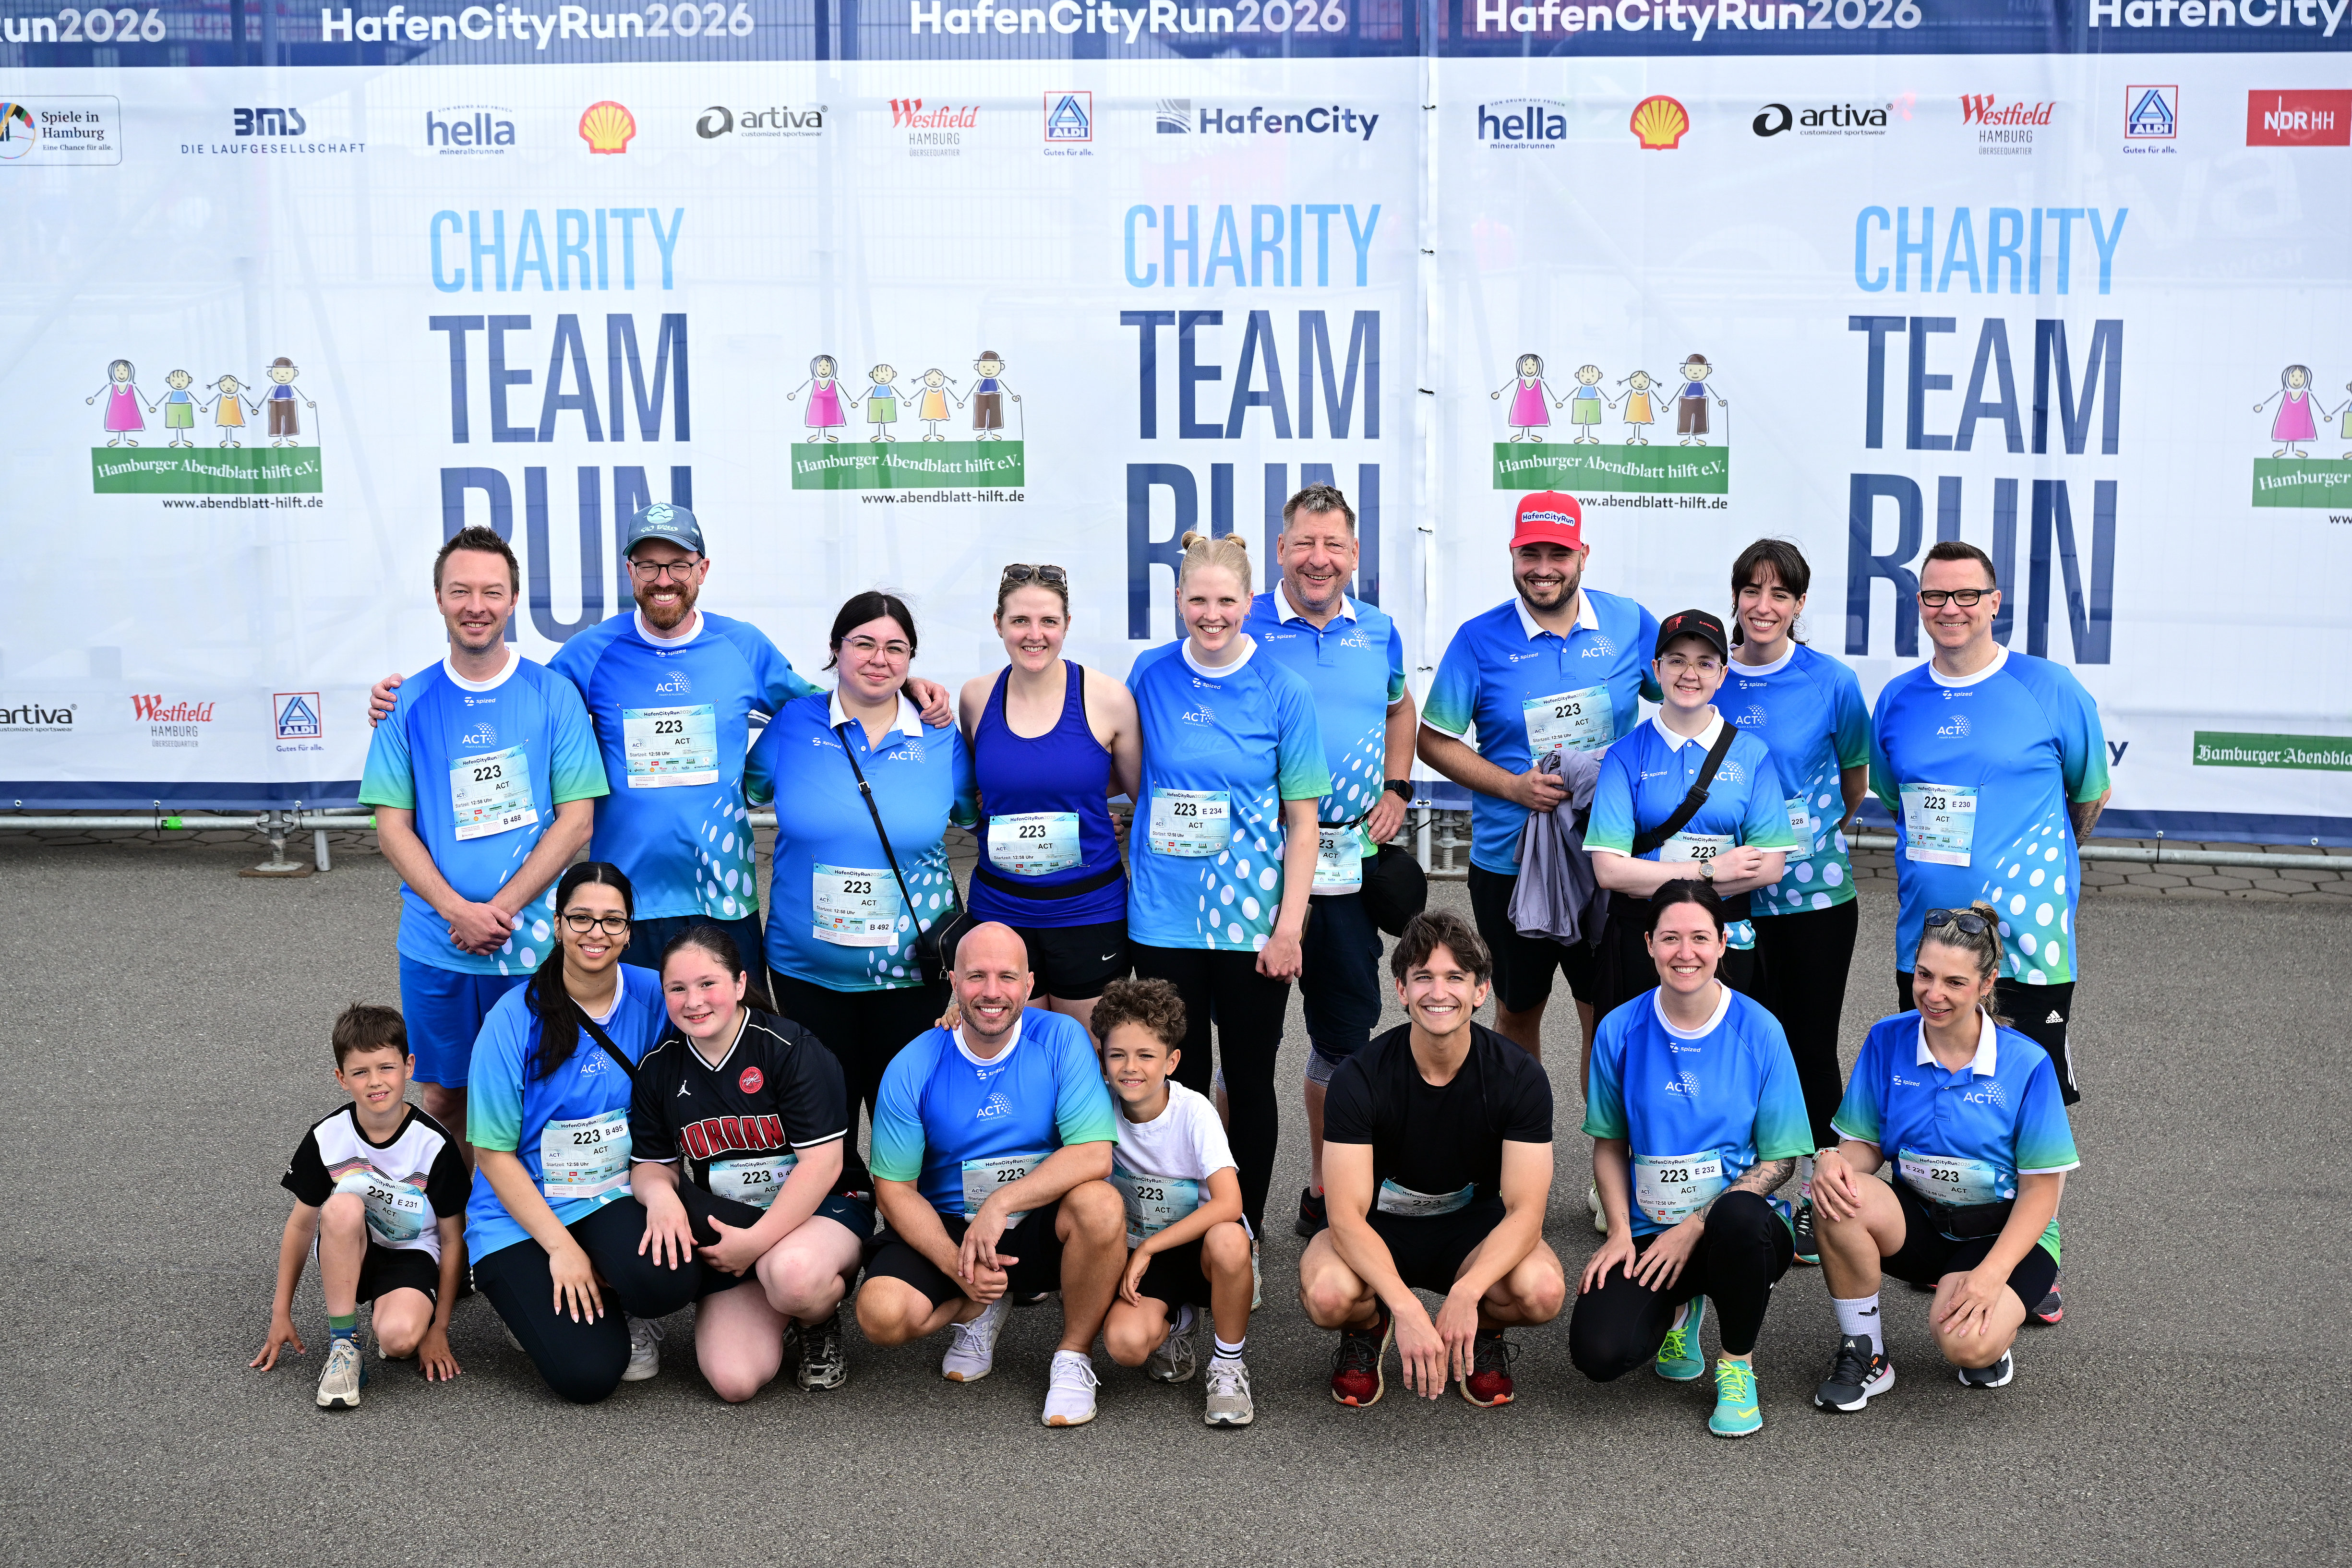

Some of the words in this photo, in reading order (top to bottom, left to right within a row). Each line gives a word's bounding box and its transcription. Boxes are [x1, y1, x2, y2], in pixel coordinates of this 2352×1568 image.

[0, 7, 166, 43] un2026
[322, 2, 754, 50] HafenCityRun2026
[912, 0, 1346, 44] HafenCityRun2026
[1476, 0, 1921, 41] HafenCityRun2026
[888, 97, 981, 129] Westfield
[1958, 94, 2056, 127] Westfield
[41, 111, 82, 125] Spiele
[86, 111, 99, 122] in
[234, 108, 306, 136] BMS
[1200, 105, 1379, 140] HafenCity
[1478, 104, 1567, 141] hella
[2264, 111, 2307, 131] NDR
[2311, 110, 2334, 131] HH
[42, 127, 105, 141] Hamburg
[427, 110, 515, 146] hella
[1052, 127, 1086, 138] ALDI
[2133, 123, 2170, 134] ALDI
[909, 132, 960, 145] HAMBURG
[1979, 130, 2033, 143] HAMBURG
[181, 145, 205, 154] DIE
[212, 144, 366, 154] LAUFGESELLSCHAFT
[909, 147, 960, 156] ÜBERSEEQUARTIER
[1979, 145, 2032, 155] ÜBERSEEQUARTIER
[2123, 145, 2146, 155] Gutes
[2148, 145, 2161, 155] für
[2162, 145, 2177, 154] alle.
[430, 207, 684, 293] CHARITY
[1124, 203, 1381, 288] CHARITY
[1855, 205, 2129, 295] CHARITY
[429, 313, 690, 443] TEAM
[1119, 310, 1381, 440] TEAM
[1848, 315, 2124, 455] TEAM
[97, 458, 179, 479] Hamburger
[180, 459, 259, 480] Abendblatt
[262, 464, 292, 479] hilft
[294, 460, 319, 476] e.V.
[796, 454, 879, 474] Hamburger
[881, 454, 962, 473] Abendblatt
[965, 458, 995, 473] hilft
[997, 454, 1021, 469] e.V.
[1498, 454, 1582, 474] Hamburger
[1584, 455, 1664, 478] Abendblatt
[1668, 464, 1699, 479] hilft
[1701, 460, 1725, 477] e.V.
[2259, 470, 2351, 491] Hamburger
[162, 496, 324, 509] www.abendblatt-hilft.de
[861, 490, 1025, 503] www.abendblatt-hilft.de
[1578, 494, 1728, 509] ww.abendblatt-hilft.de
[1523, 511, 1575, 525] HafenCityRun
[1582, 647, 1606, 658] ACT
[656, 682, 681, 692] ACT
[1202, 682, 1221, 690] spized
[1543, 692, 1587, 705] HafenCityRun2026
[130, 694, 216, 722] Westfield
[1555, 703, 1581, 718] 223
[151, 725, 198, 737] HAMBURG
[283, 725, 316, 735] ALDI
[655, 720, 683, 734] 223
[1936, 726, 1962, 735] ACT
[152, 739, 199, 748] ÜBERSEEQUARTIER
[462, 734, 488, 744] ACT
[463, 753, 508, 766] HafenCityRun2026
[888, 751, 916, 761] ACT
[2196, 744, 2281, 765] Hamburger
[474, 765, 502, 782] 223
[496, 781, 509, 790] ACT
[1174, 802, 1197, 816] 223
[1924, 796, 1945, 810] 223
[510, 814, 521, 823] 488
[1019, 825, 1046, 838] 223
[1692, 846, 1716, 859] 223
[834, 869, 883, 877] HafenCityRun2026
[844, 880, 871, 894] 223
[1665, 1081, 1690, 1093] ACT
[976, 1104, 1001, 1118] ACT
[561, 1116, 607, 1129] HafenCityRun2026
[573, 1129, 601, 1145] 223
[612, 1125, 623, 1135] 495
[593, 1145, 608, 1155] ACT
[985, 1158, 1036, 1167] HafenCityRun2026
[1920, 1158, 1970, 1167] HafenCityRun2026
[742, 1171, 771, 1185] 223
[1128, 1174, 1175, 1185] HafenCityRun2026
[1660, 1169, 1688, 1183] 223
[1931, 1168, 1959, 1183] 223
[367, 1185, 394, 1205] 223
[1137, 1186, 1164, 1200] 223
[1681, 1186, 1696, 1194] ACT
